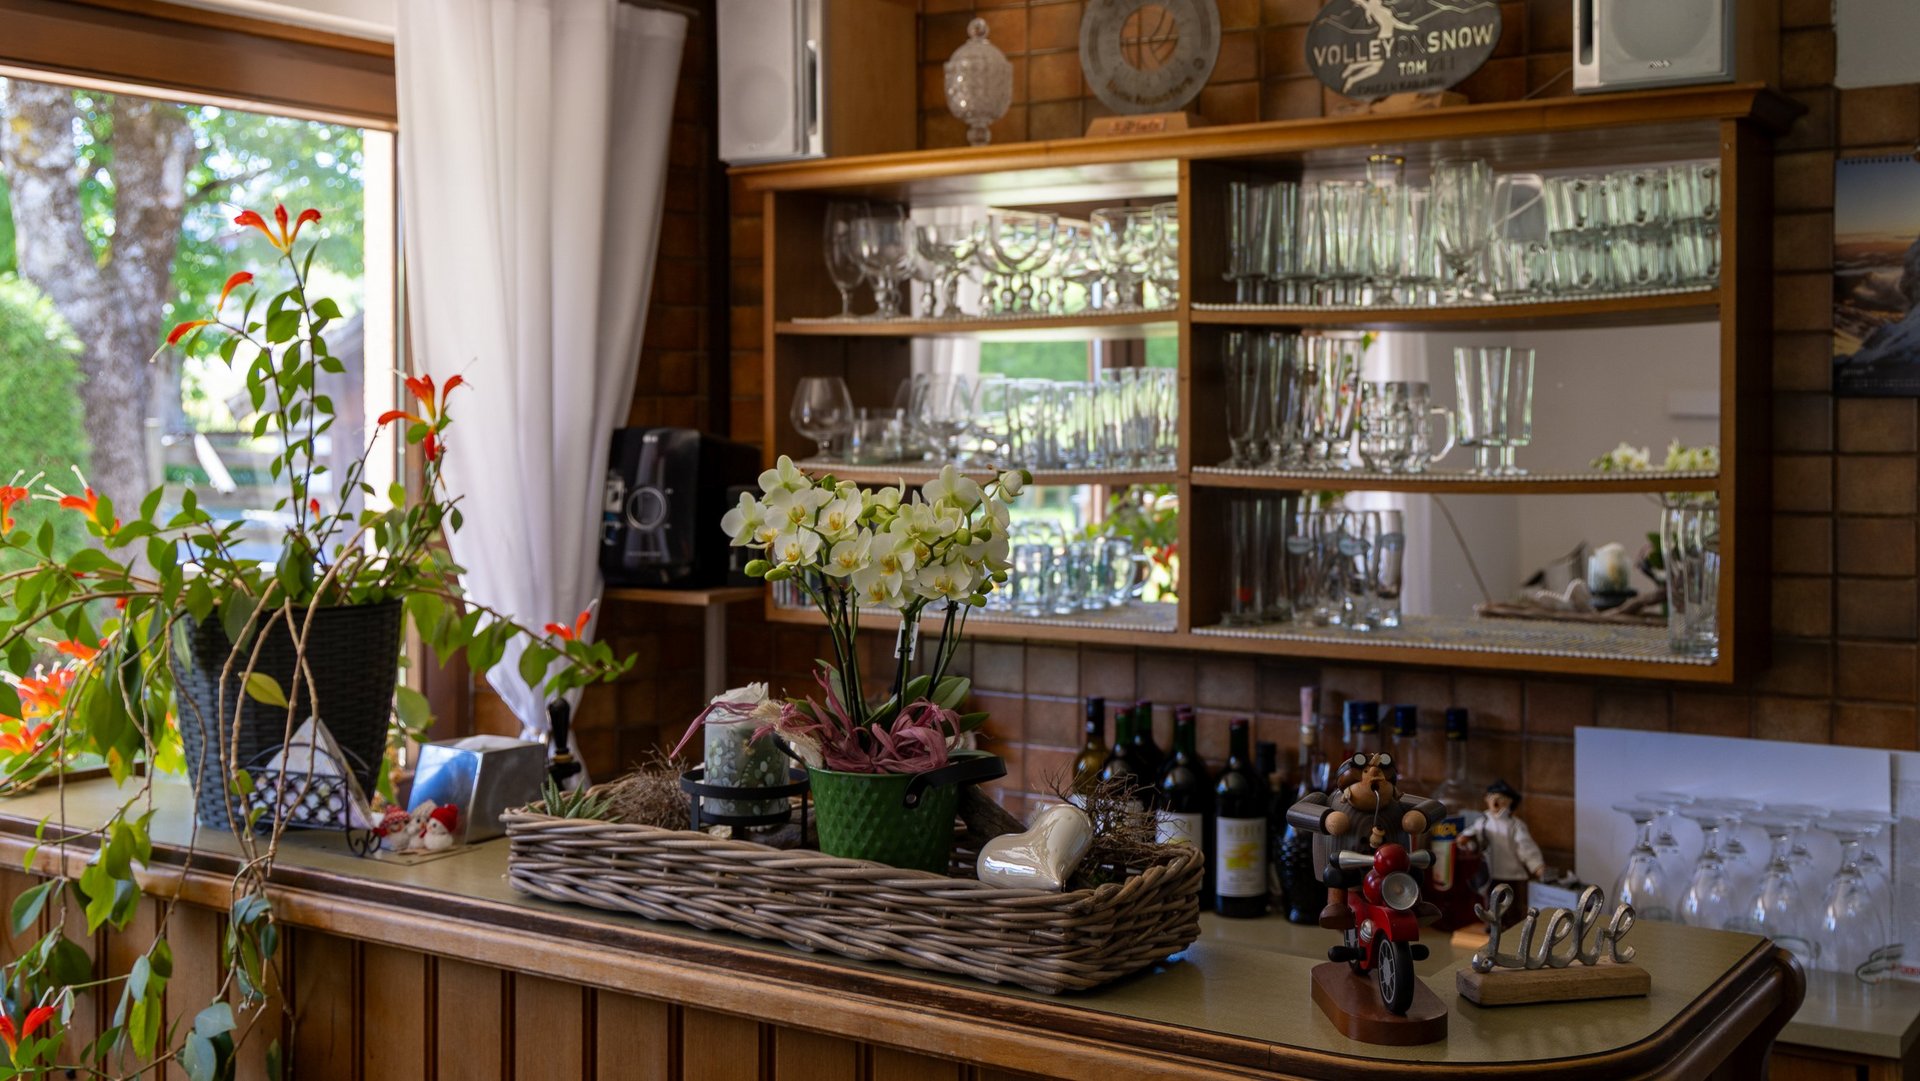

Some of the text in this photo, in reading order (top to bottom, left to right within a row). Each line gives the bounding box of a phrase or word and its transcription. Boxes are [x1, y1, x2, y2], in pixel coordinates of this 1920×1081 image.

[1313, 38, 1394, 67] VOLLEY
[1428, 23, 1494, 53] SNOW
[1398, 60, 1427, 76] TOM
